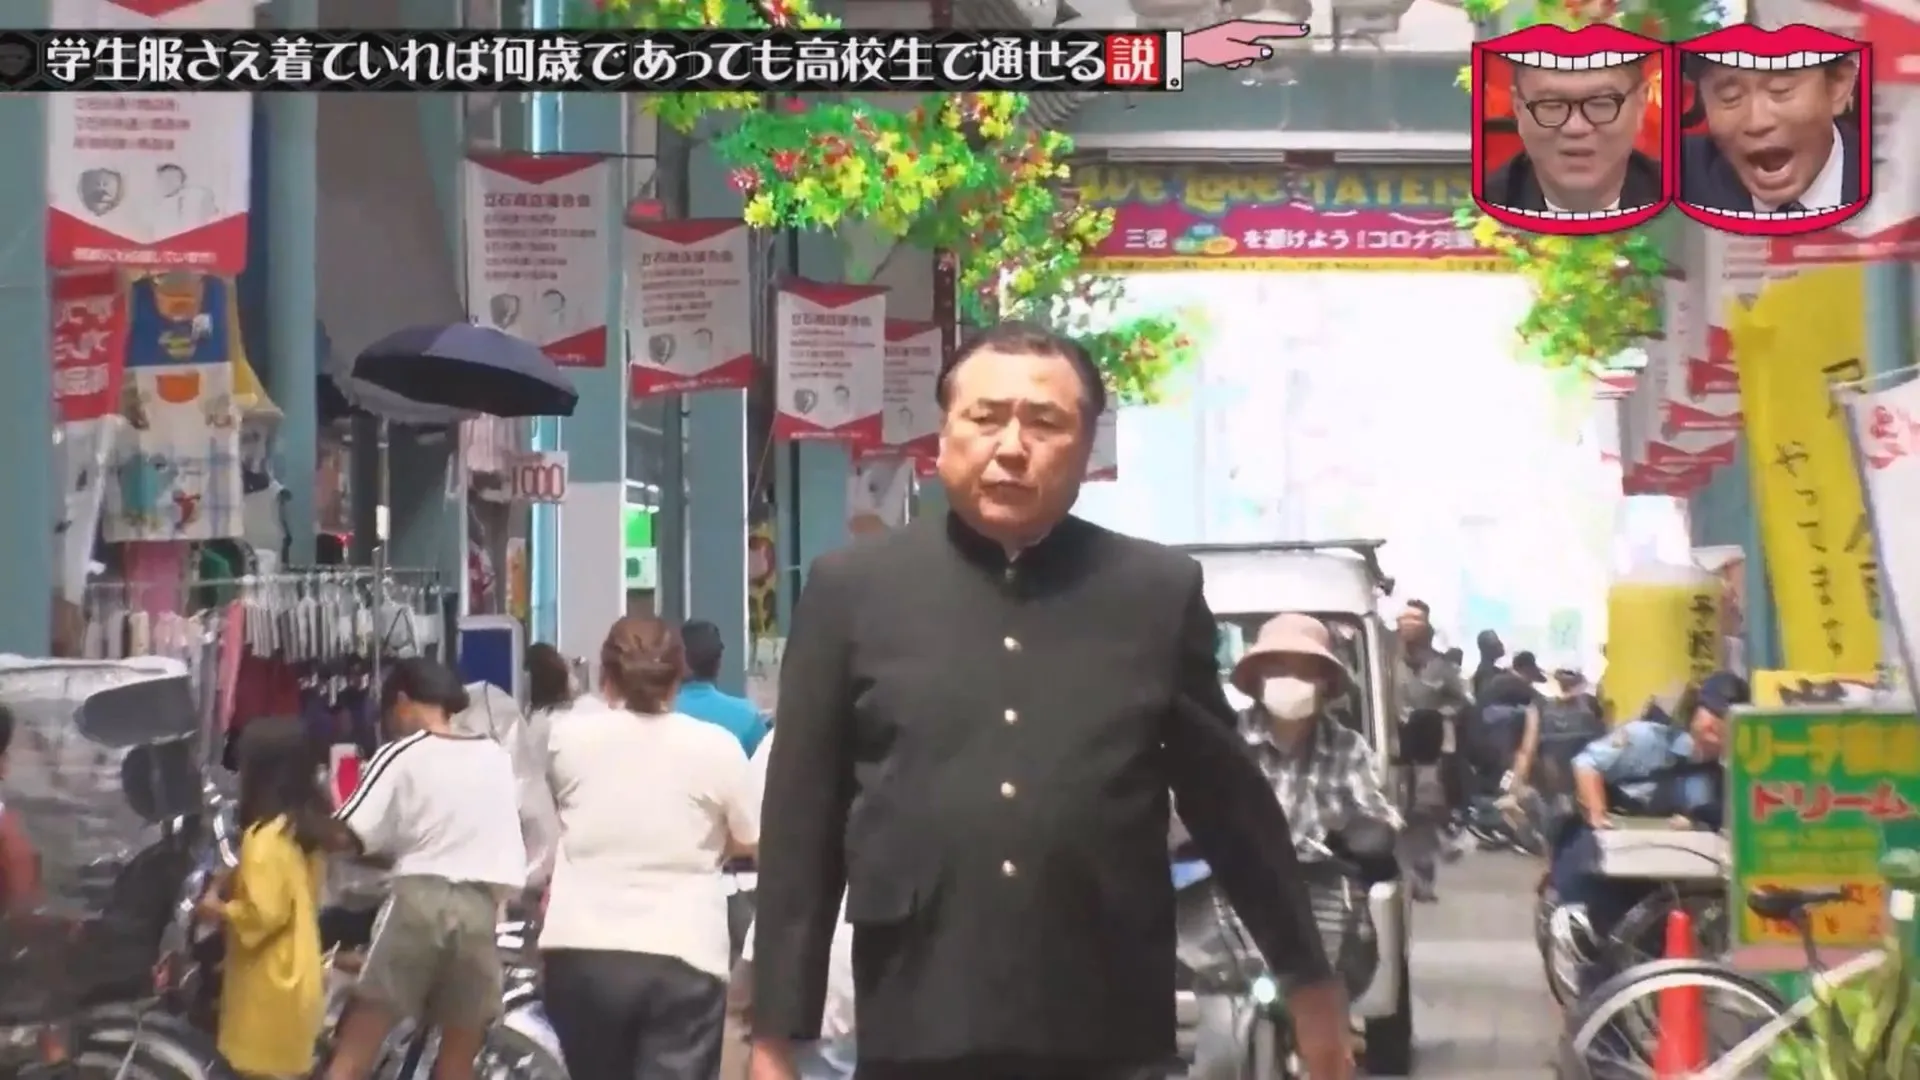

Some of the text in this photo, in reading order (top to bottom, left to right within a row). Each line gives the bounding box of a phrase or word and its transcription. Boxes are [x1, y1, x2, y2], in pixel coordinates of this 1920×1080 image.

[512, 464, 565, 500] 1000
[1751, 780, 1917, 823] ドリーム
